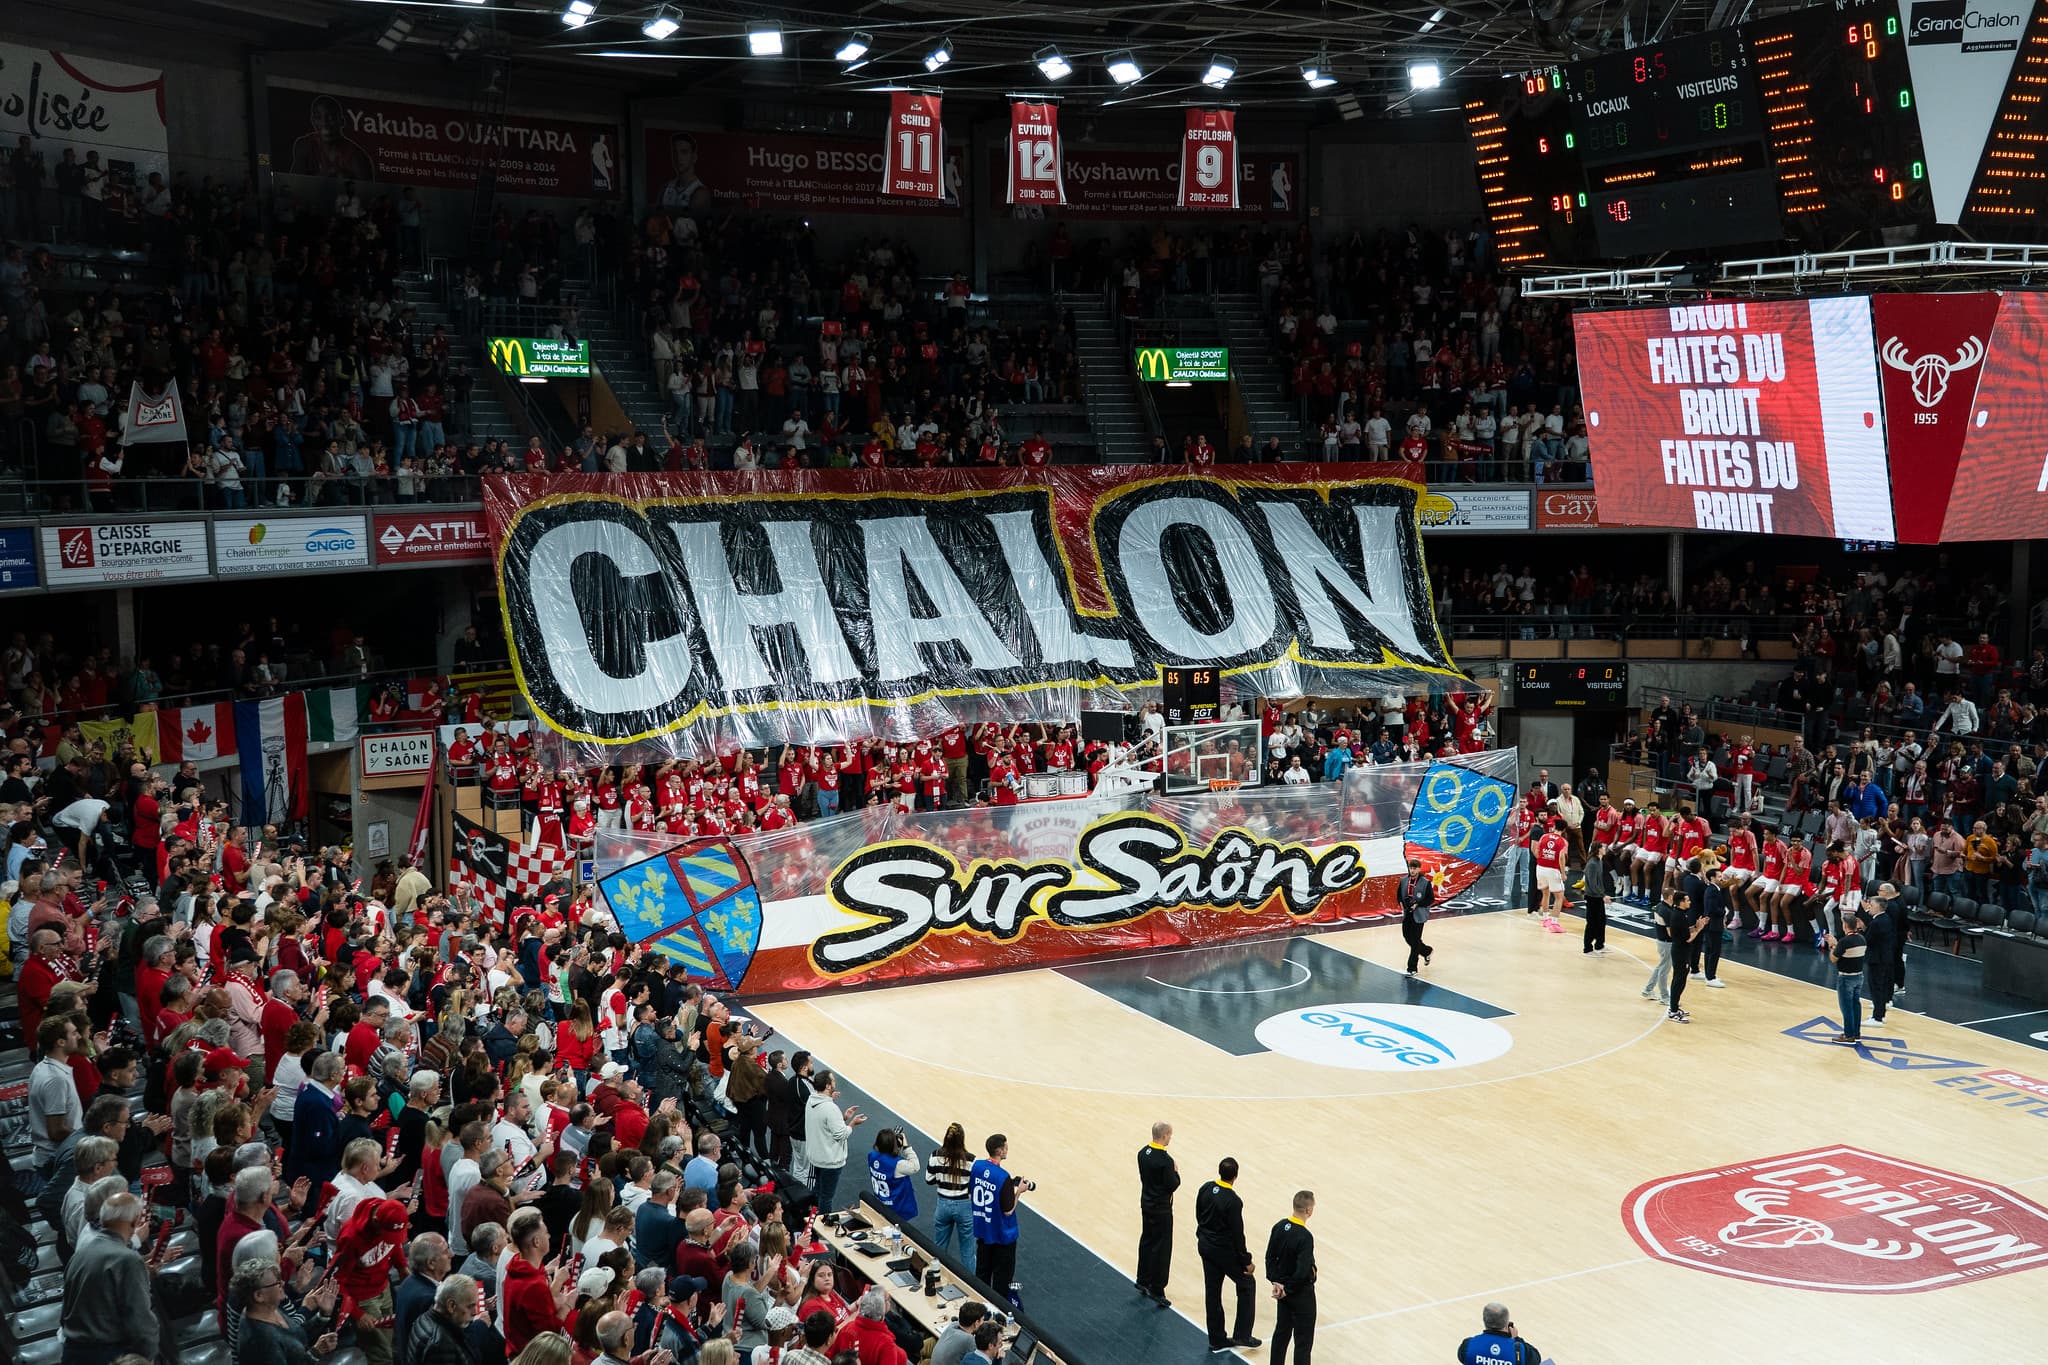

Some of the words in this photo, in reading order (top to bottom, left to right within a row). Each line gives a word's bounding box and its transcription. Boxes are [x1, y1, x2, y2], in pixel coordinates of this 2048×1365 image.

[1917, 15, 1963, 32] Grand
[1966, 11, 2019, 29] Chalon
[1910, 30, 1919, 38] le
[1544, 65, 1560, 77] PTS
[0, 57, 110, 139] olisée
[1676, 75, 1738, 101] VISITEURS
[1587, 96, 1631, 119] LOCAUX
[347, 109, 438, 141] Yakuba
[445, 120, 577, 153] OUATTARA
[900, 113, 932, 128] SCHILB
[1187, 130, 1232, 142] SEFOLOSHA
[747, 145, 809, 173] Hugo
[816, 151, 883, 173] BESSO
[899, 131, 934, 174] 11
[1018, 140, 1056, 181] 12
[1065, 161, 1160, 184] Kyshawn
[1196, 145, 1224, 189] 9
[895, 180, 934, 193] 2009-2013
[1200, 351, 1223, 359] SPORT
[1648, 335, 1739, 384] FAITES
[1743, 333, 1785, 383] DU
[1679, 388, 1761, 436] BRUIT
[1914, 412, 1938, 425] 1955
[1660, 440, 1752, 488] FAITES
[1755, 441, 1799, 490] DU
[1566, 493, 1597, 501] Minoteri
[1545, 494, 1598, 522] Gay
[1693, 493, 1774, 533] BRUIT
[99, 525, 151, 540] CAISSE
[405, 522, 490, 542] ATTIL
[100, 540, 182, 557] D'EPARGNE
[405, 543, 434, 553] répare
[435, 542, 443, 551] et
[444, 541, 483, 551] entretient
[102, 558, 140, 568] Bourgogne
[141, 555, 193, 565] Franche-Comté
[103, 571, 124, 582] Vous
[126, 570, 144, 580] être
[529, 496, 1434, 716] CHALON
[1169, 709, 1181, 717] EGT
[1194, 708, 1212, 718] EGT
[370, 740, 428, 753] CHALON
[385, 753, 430, 767] SAÔNE
[1024, 817, 1050, 832] KOP
[816, 853, 1070, 974] Sur
[1050, 817, 1363, 928] Saône
[975, 1177, 997, 1192] PHOTO
[973, 1185, 994, 1207] 02
[1900, 1179, 2004, 1215] ELAN
[1753, 1163, 2042, 1267] CHALON
[1674, 1235, 1731, 1257] 1955
